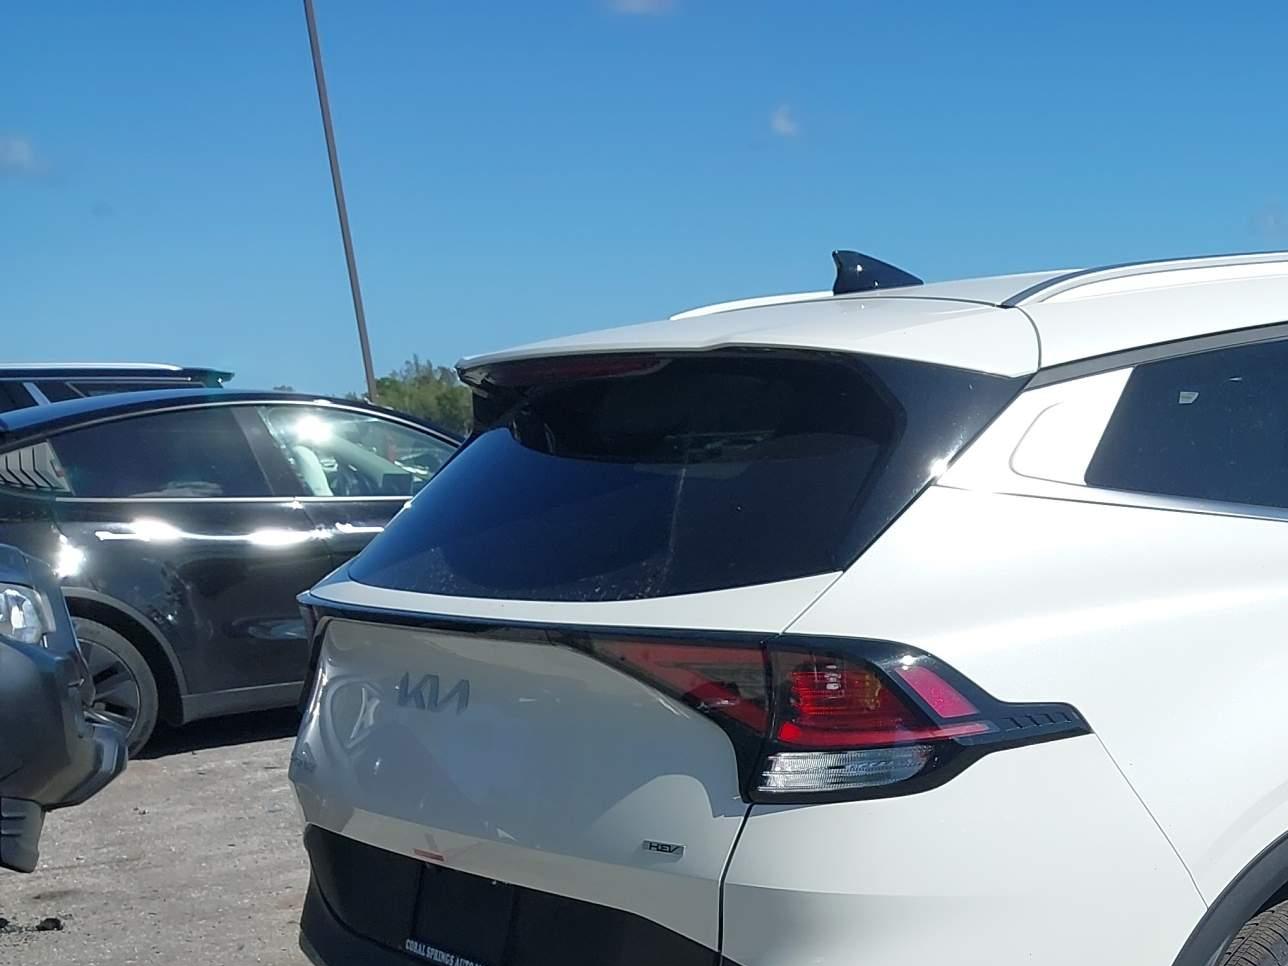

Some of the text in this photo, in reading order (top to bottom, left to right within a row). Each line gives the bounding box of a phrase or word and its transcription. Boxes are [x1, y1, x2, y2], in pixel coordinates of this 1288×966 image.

[397, 671, 471, 717] KIA
[648, 842, 682, 854] HEV
[405, 938, 426, 956] CORAL
[426, 946, 455, 966] SPRINGS
